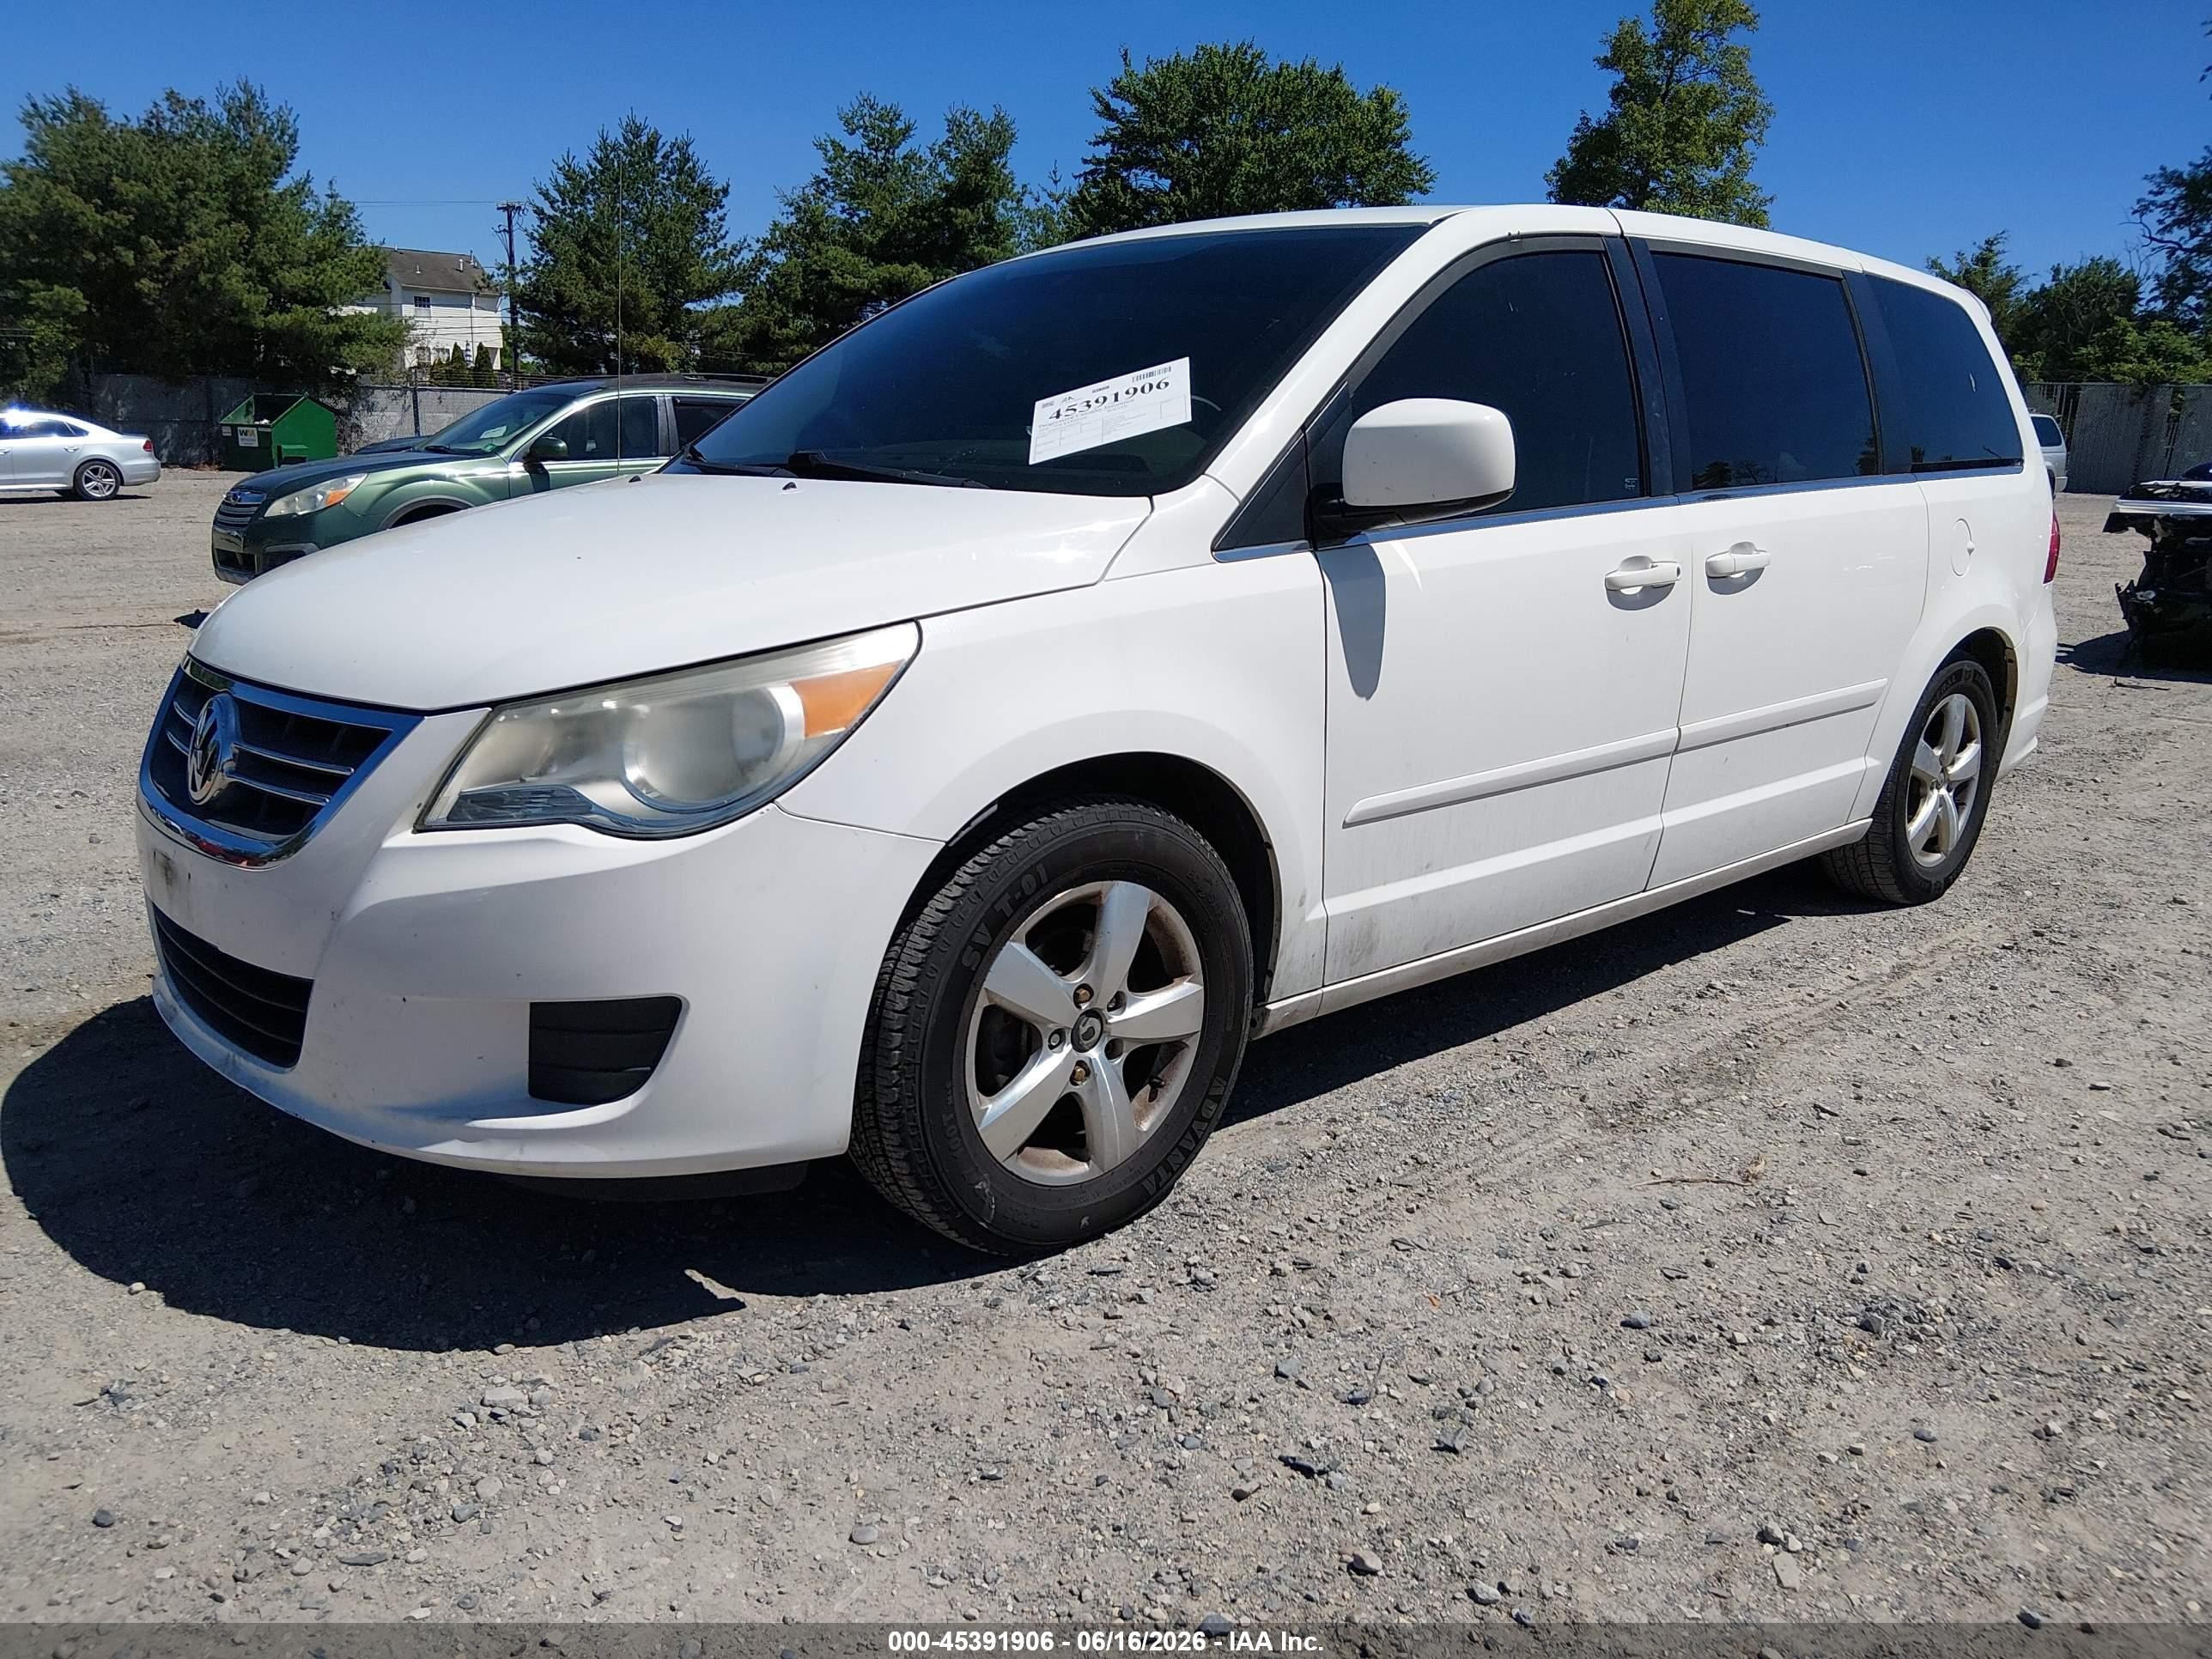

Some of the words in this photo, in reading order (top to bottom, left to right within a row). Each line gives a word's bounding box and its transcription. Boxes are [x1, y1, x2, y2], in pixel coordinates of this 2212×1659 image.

[1048, 377, 1170, 421] 45391906
[961, 922, 994, 972] SV
[1139, 1076, 1228, 1197] ADVANTA
